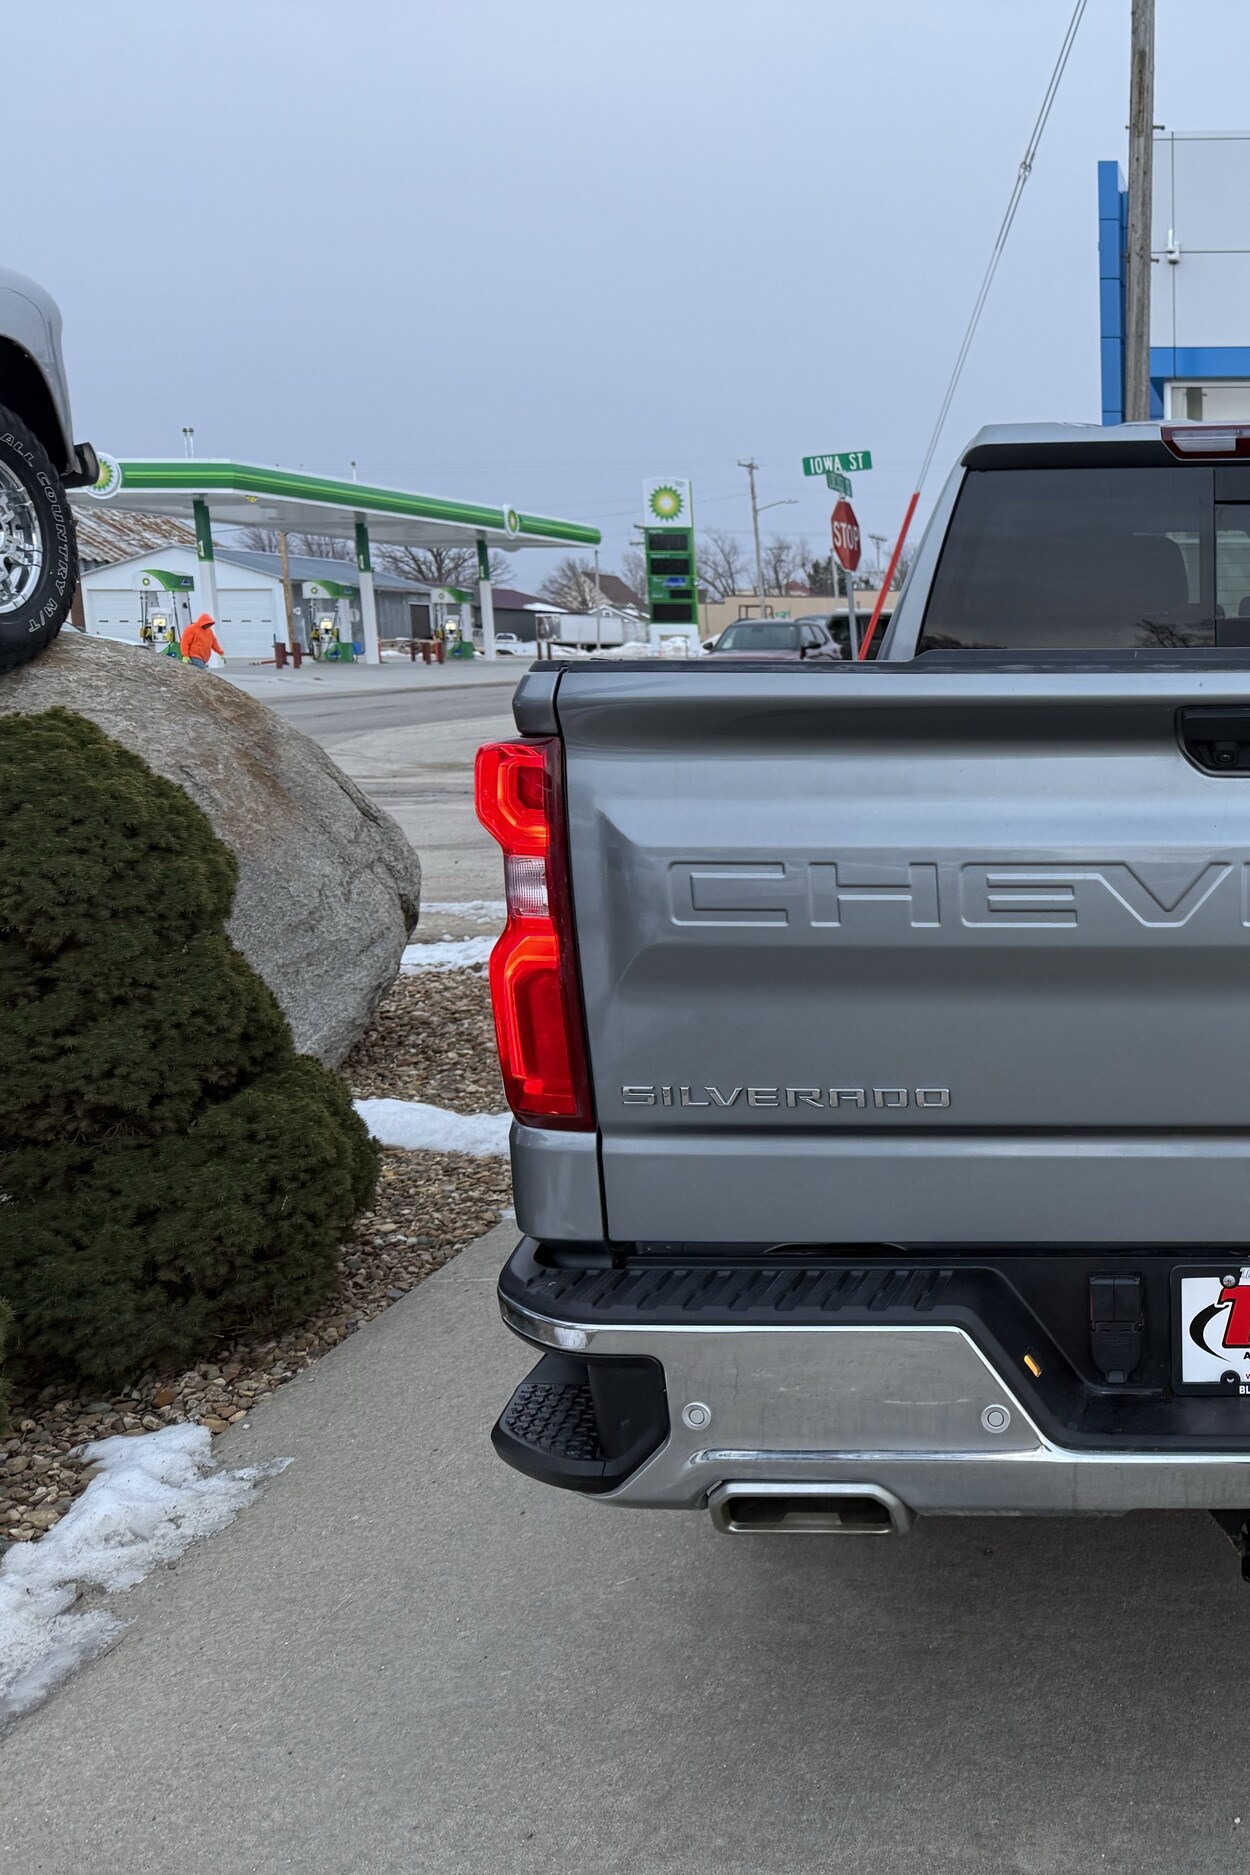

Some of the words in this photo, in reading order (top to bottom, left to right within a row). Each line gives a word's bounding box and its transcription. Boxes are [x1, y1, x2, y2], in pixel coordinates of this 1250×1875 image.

[0, 432, 34, 467] ALL
[809, 456, 843, 474] IOWA
[848, 453, 864, 470] ST
[37, 471, 69, 596] COUNTRY
[833, 521, 860, 551] STOP
[29, 597, 59, 633] M/T
[621, 1085, 951, 1108] SILVERADO
